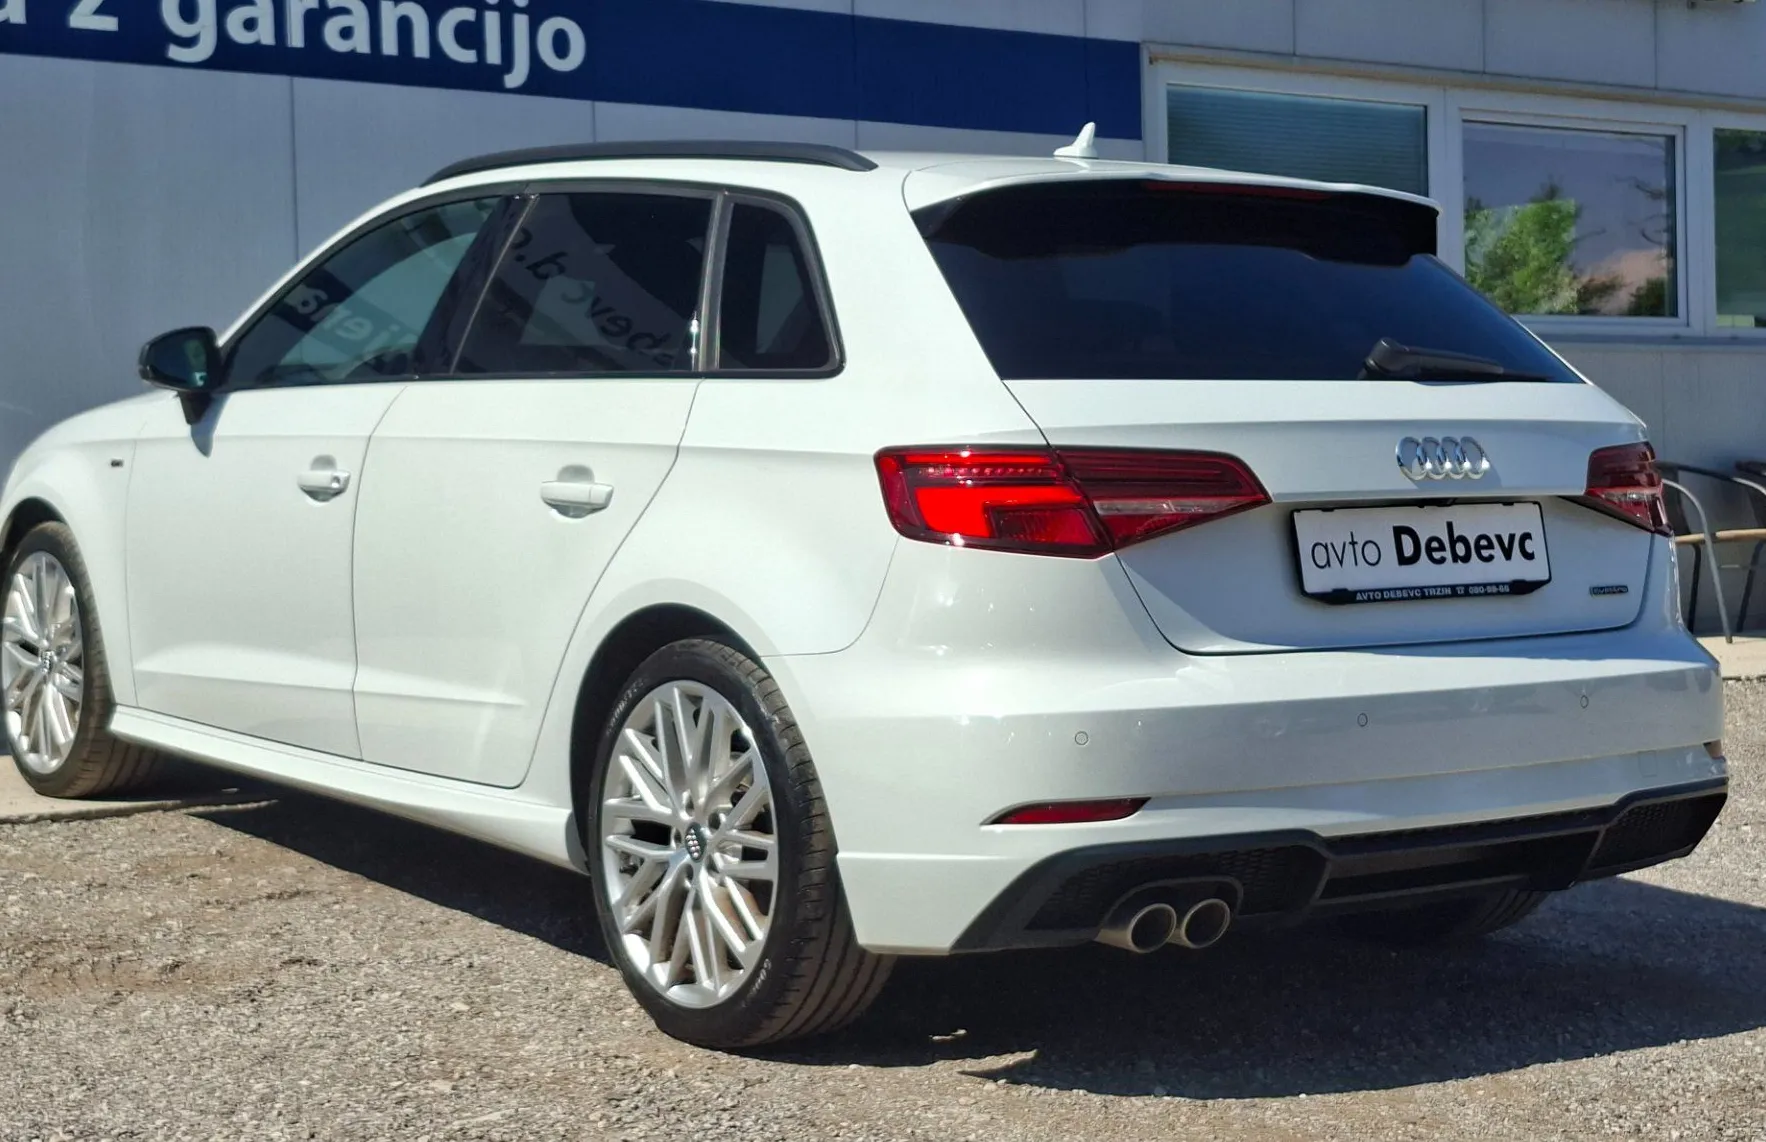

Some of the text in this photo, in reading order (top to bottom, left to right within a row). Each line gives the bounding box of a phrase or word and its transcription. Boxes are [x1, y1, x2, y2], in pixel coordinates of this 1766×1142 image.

[161, 0, 587, 89] garancijo
[1311, 521, 1535, 569] avto Debevc
[1356, 591, 1382, 601] AVTO
[1383, 590, 1421, 599] DEBEVC
